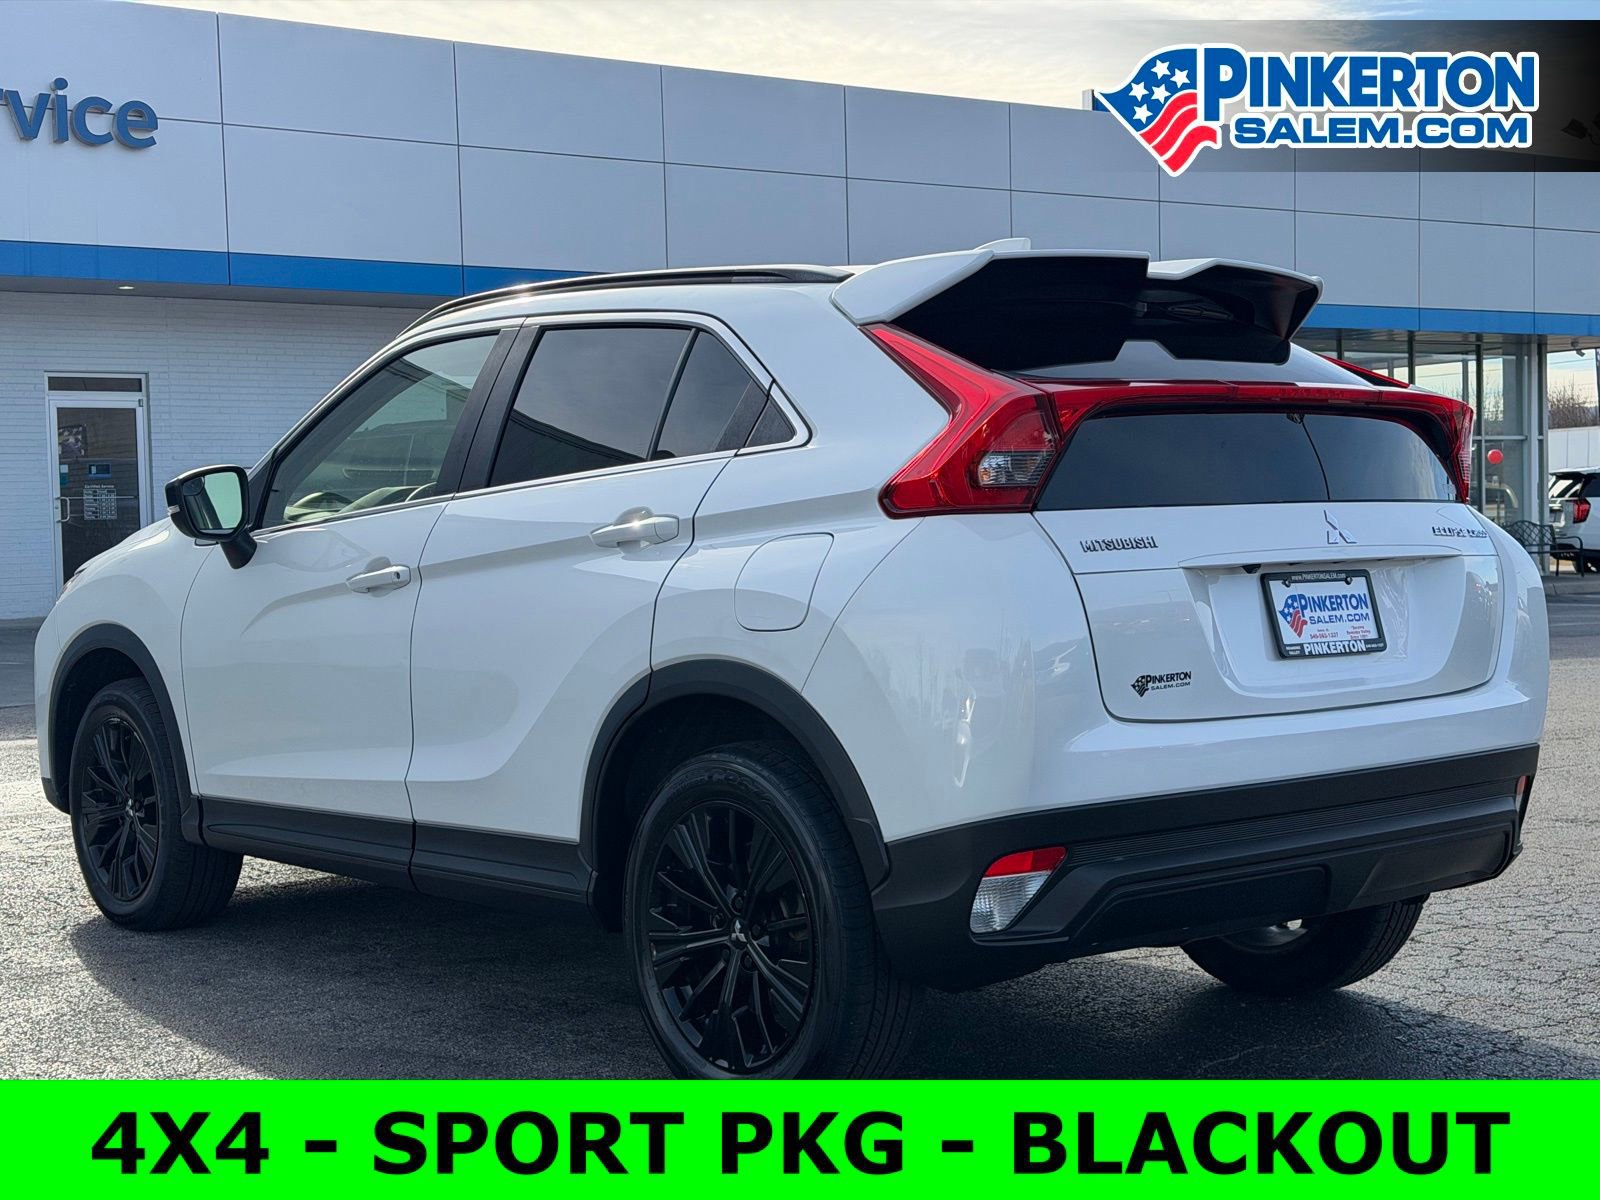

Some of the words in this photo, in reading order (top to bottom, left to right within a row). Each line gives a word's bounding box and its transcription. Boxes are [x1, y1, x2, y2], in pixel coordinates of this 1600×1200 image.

[0, 77, 158, 149] vice
[1080, 536, 1159, 552] MITSUBISHI
[1299, 593, 1369, 618] PINKERTON
[1308, 613, 1370, 625] SALEM.COM
[1303, 640, 1367, 655] PINKERTON
[1145, 671, 1192, 687] PINKERTON
[1150, 681, 1191, 691] SALEM.COM
